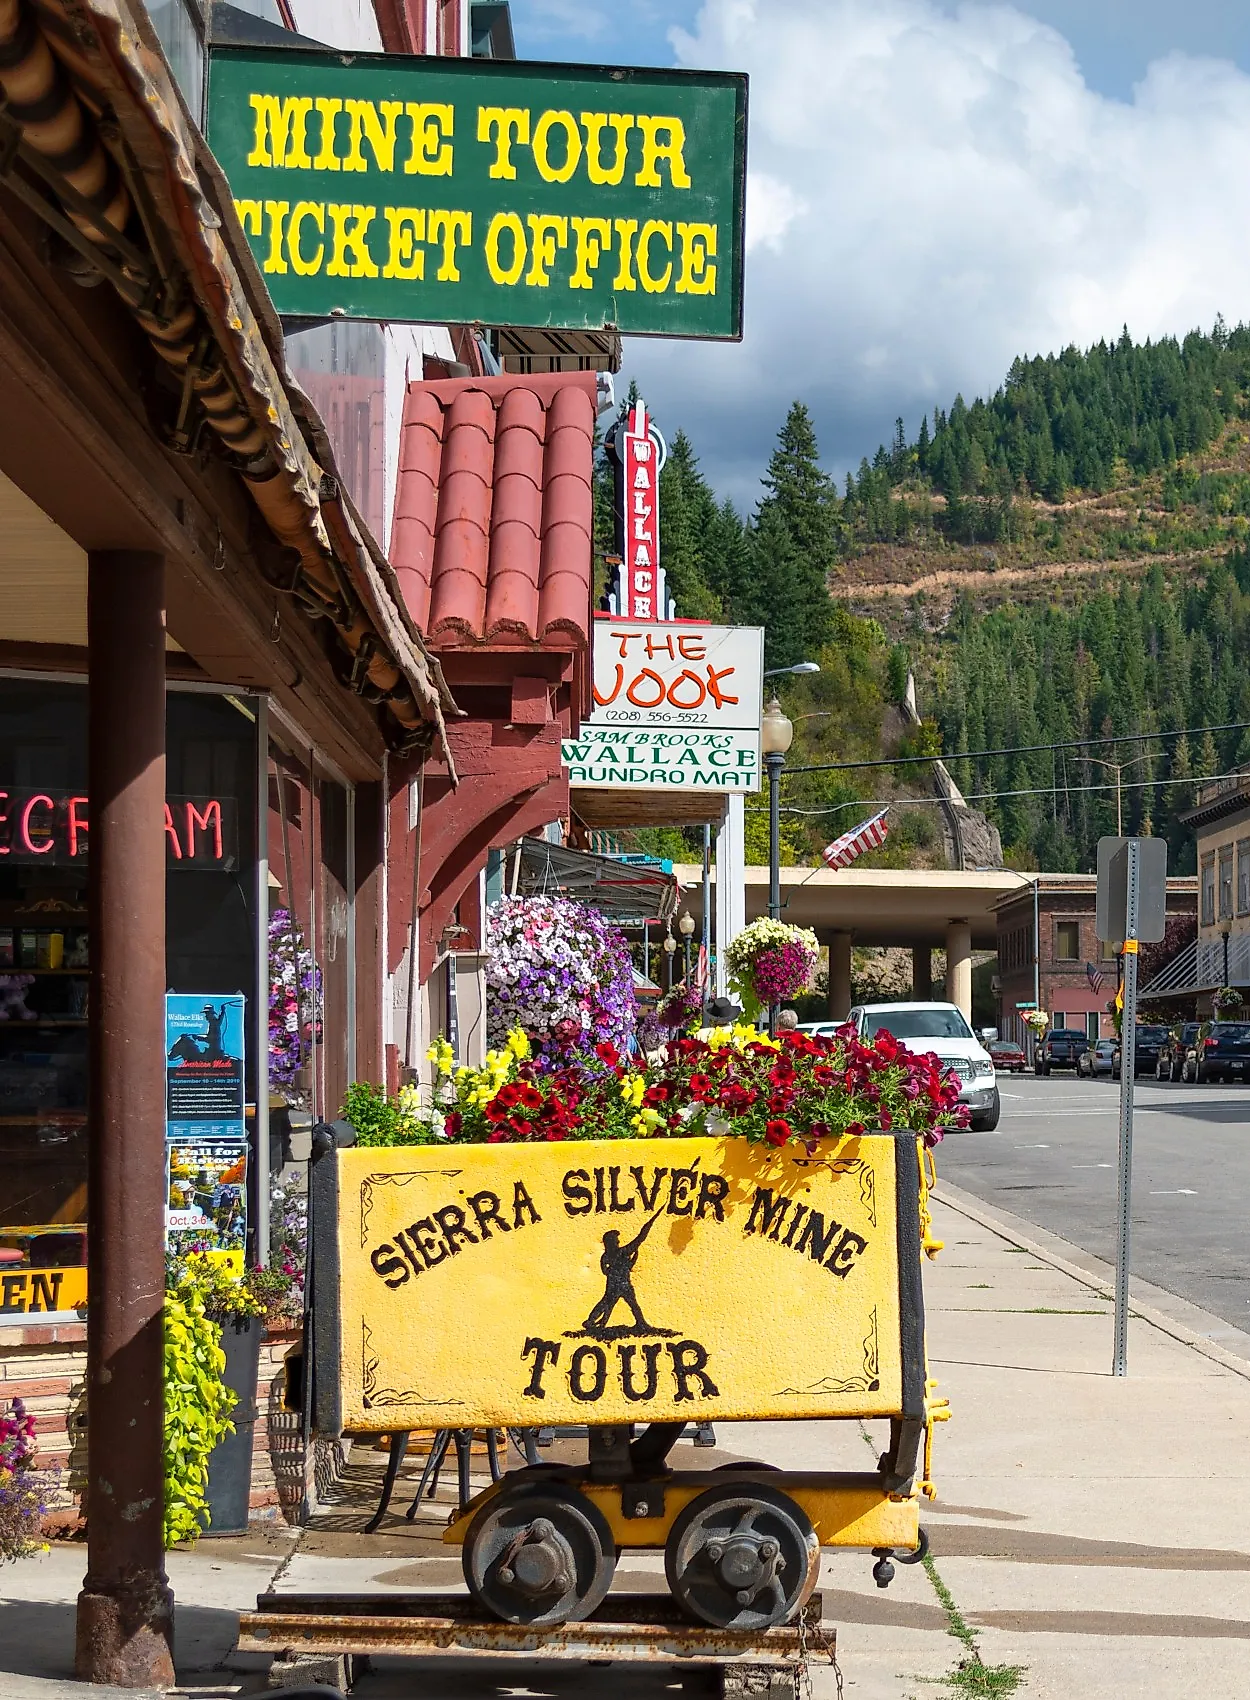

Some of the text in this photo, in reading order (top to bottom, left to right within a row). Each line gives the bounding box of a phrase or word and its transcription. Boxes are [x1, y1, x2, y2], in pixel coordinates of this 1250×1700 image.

[247, 93, 691, 189] MINE TOUR
[485, 212, 717, 296] OFFICE
[632, 440, 653, 618] WALLACE
[610, 632, 707, 660] THE
[605, 710, 709, 724] (208) 556-5522
[561, 744, 756, 767] WALLACE
[569, 766, 757, 787] AUNDRO MAT
[168, 1013, 191, 1021] Wallace
[177, 1147, 241, 1156] Fall for
[177, 1157, 241, 1166] History
[169, 1214, 207, 1226] Oct. 3-6
[370, 1164, 869, 1290] SIERRA SILVER MINE
[522, 1336, 721, 1403] TOUR
